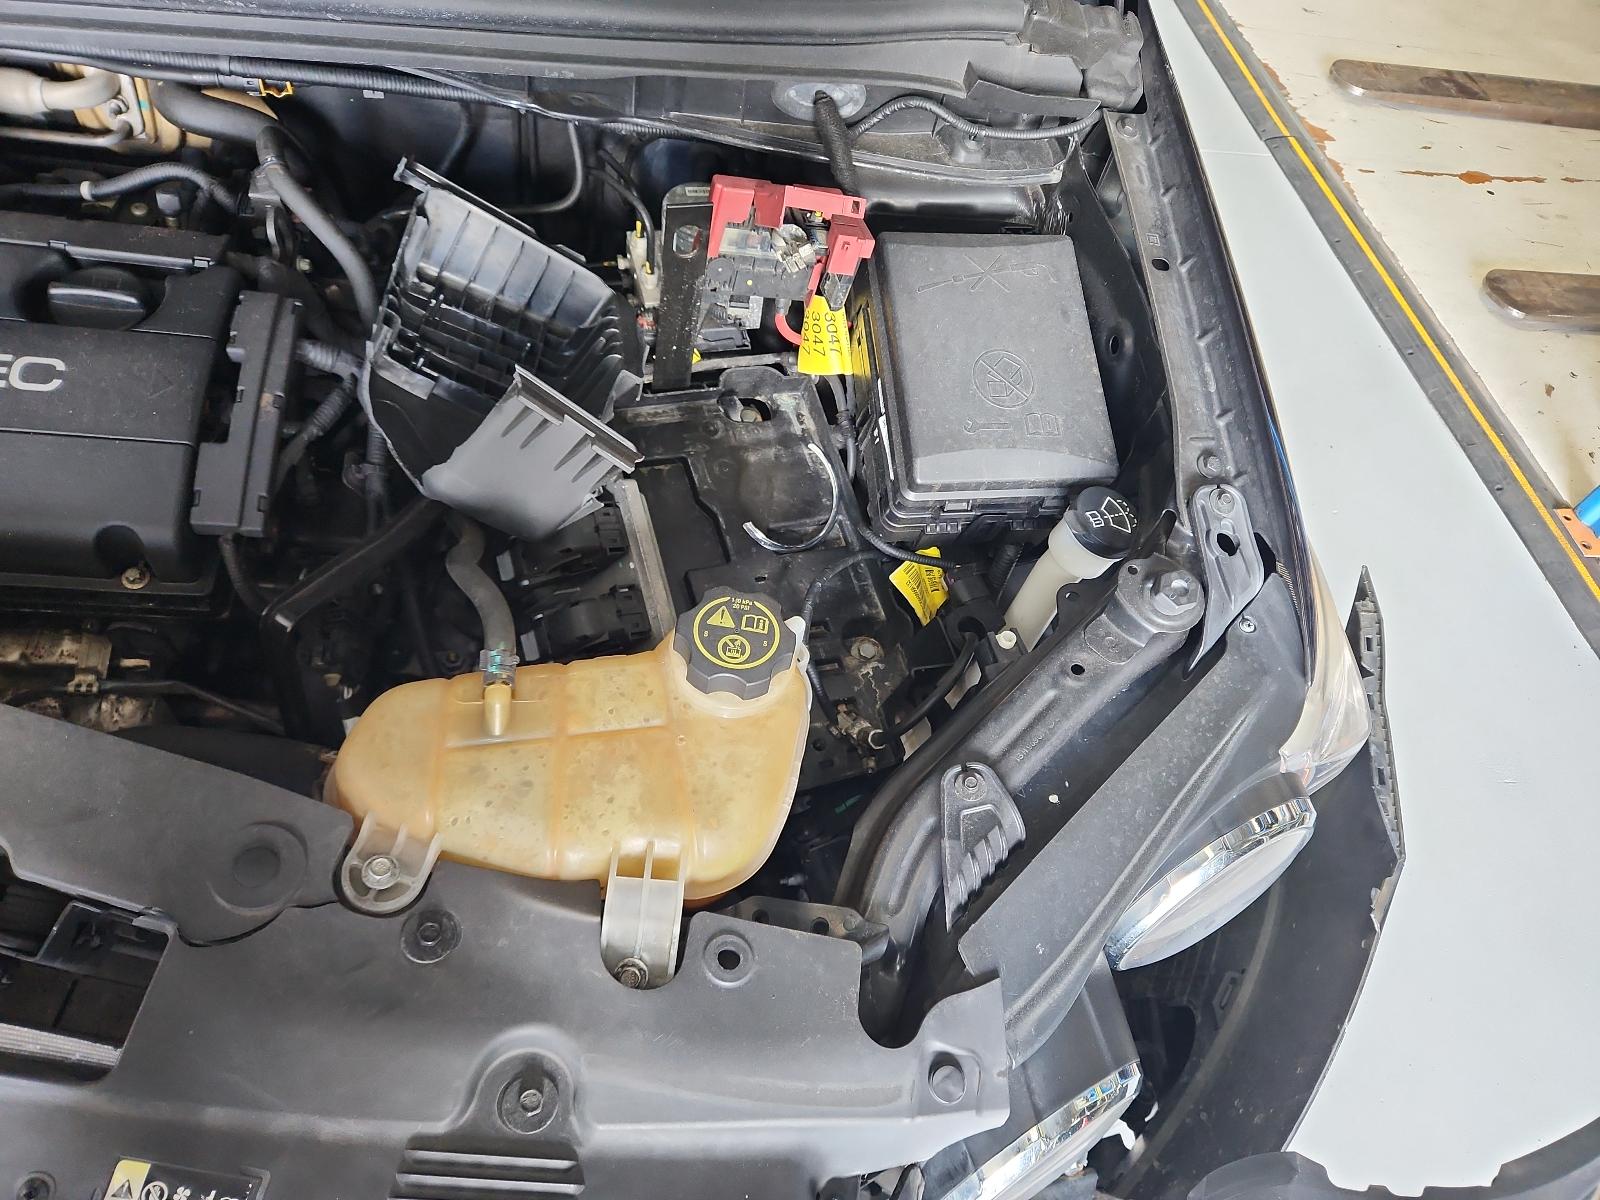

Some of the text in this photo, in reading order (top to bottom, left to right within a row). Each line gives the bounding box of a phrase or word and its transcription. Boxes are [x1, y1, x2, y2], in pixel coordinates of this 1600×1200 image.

[811, 311, 826, 357] 3047
[824, 312, 843, 356] 3047
[742, 598, 753, 606] kPa
